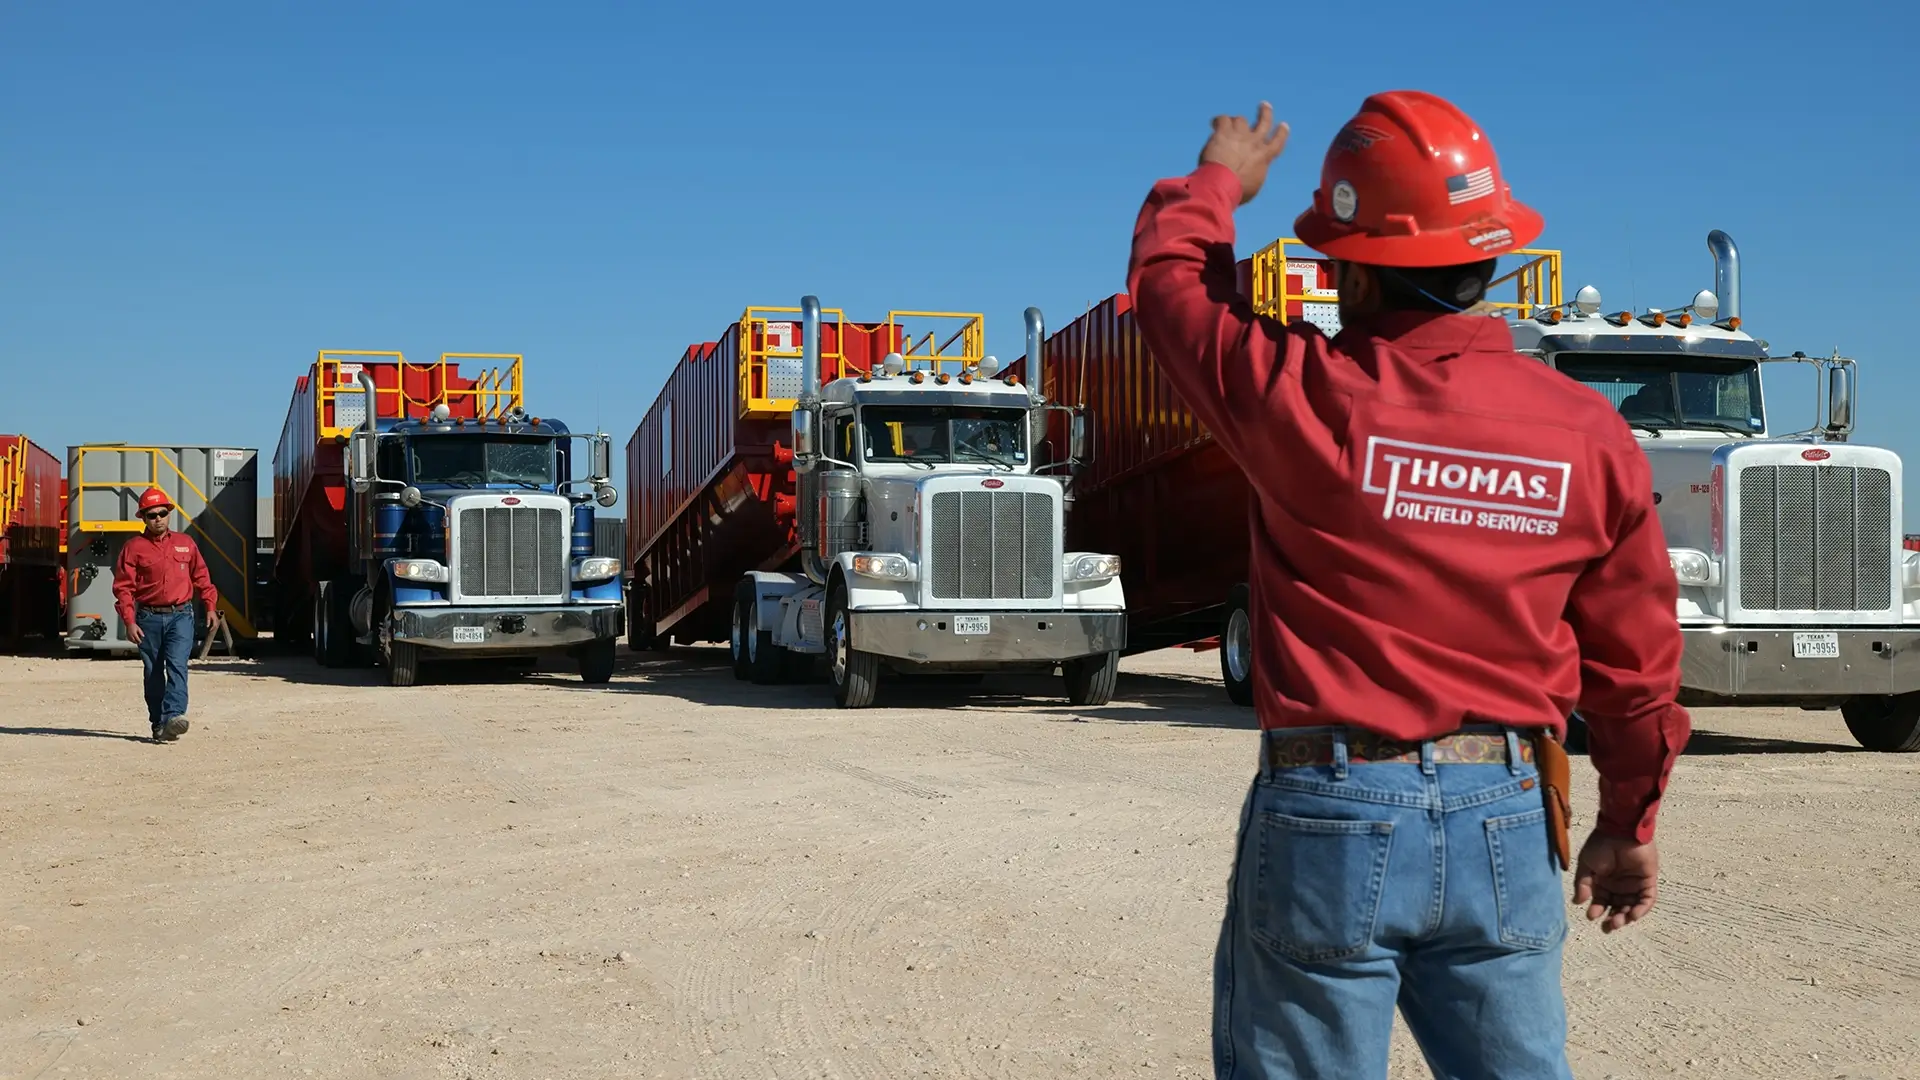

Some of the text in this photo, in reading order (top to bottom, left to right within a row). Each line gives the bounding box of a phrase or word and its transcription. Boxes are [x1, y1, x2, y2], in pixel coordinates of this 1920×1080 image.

[1383, 453, 1548, 520] THOMAS
[1395, 501, 1559, 536] OILFIELD SERVICES
